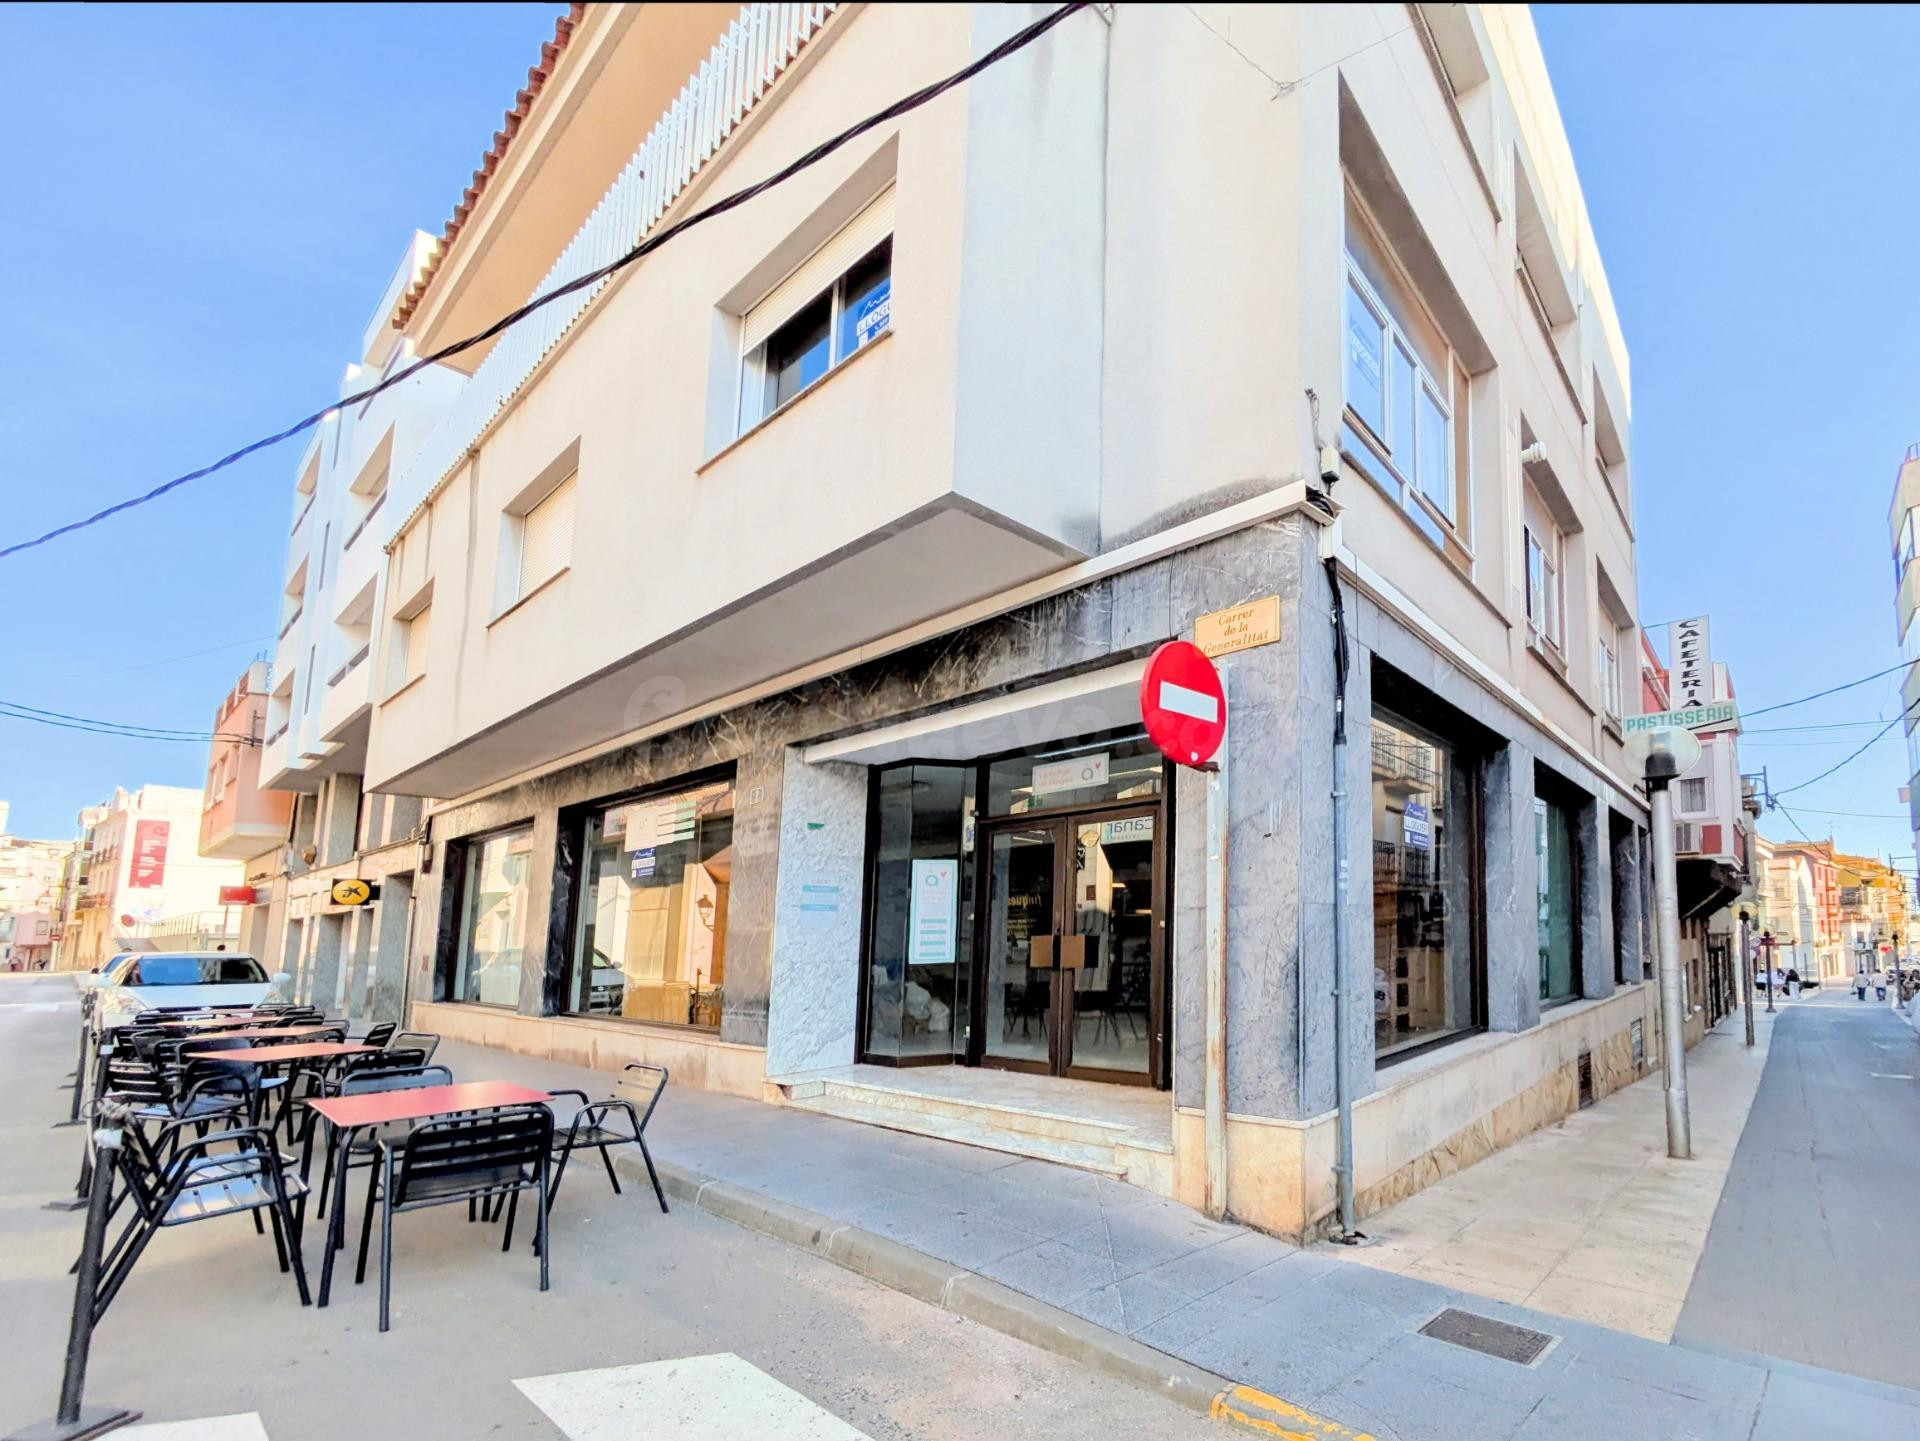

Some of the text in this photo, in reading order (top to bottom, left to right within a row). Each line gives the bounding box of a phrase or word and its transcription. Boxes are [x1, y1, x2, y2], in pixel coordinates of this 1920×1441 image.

[1218, 609, 1255, 626] Carrer
[1223, 621, 1249, 638] de la
[1678, 619, 1703, 709] CAFETERIA
[1626, 705, 1734, 732] PASTISSERIA
